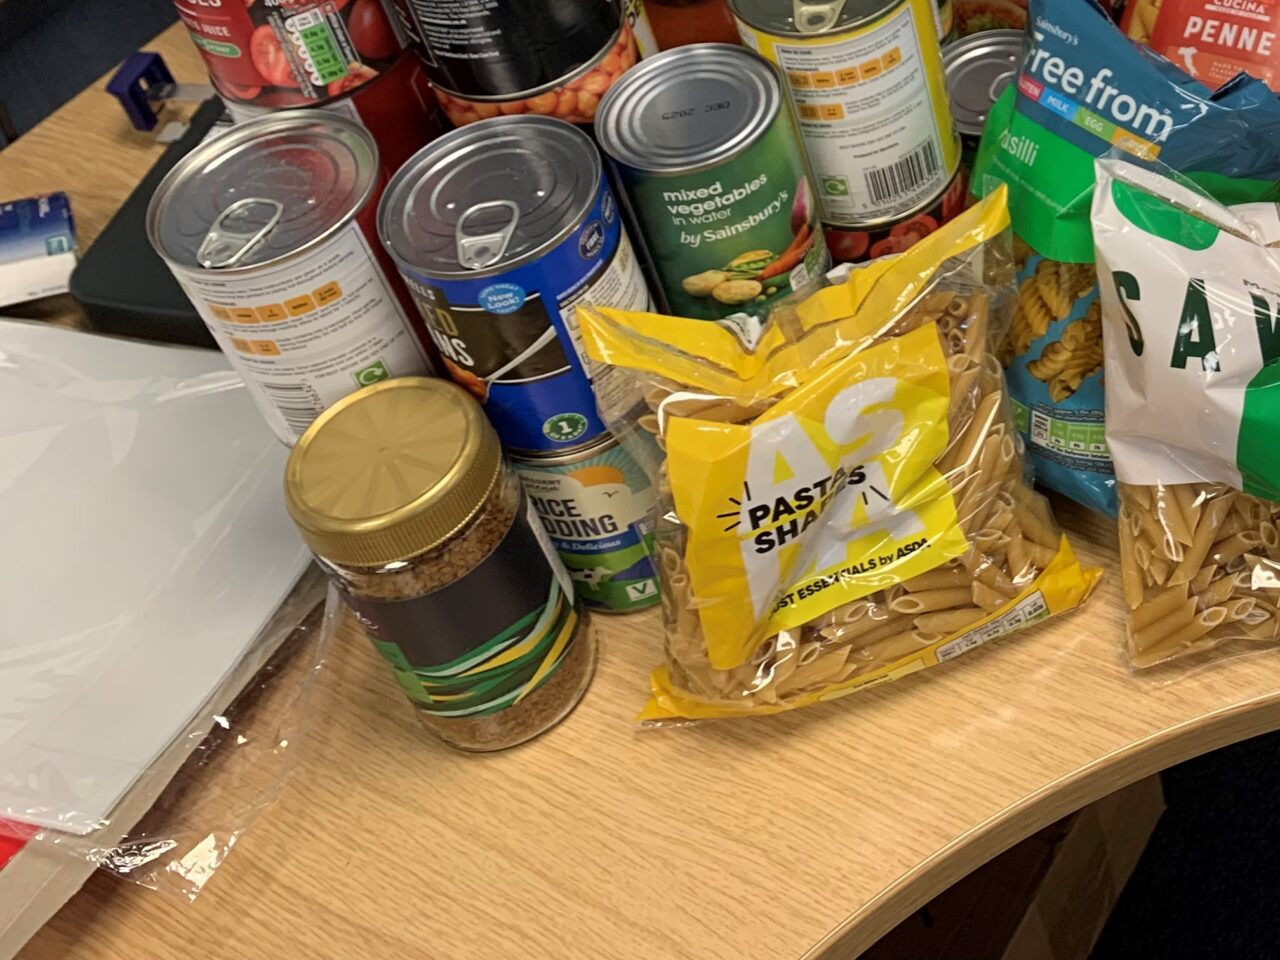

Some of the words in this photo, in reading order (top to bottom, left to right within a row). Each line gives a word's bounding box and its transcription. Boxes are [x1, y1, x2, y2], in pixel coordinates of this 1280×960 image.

[1036, 16, 1079, 46] Sainsbury's
[1183, 16, 1277, 56] PENNE
[1046, 95, 1070, 113] MILK
[1084, 68, 1174, 142] from
[1084, 116, 1103, 132] EGG
[663, 181, 723, 202] mixed
[666, 173, 768, 216] vegetables
[672, 215, 686, 226] in
[689, 208, 731, 225] water
[680, 232, 702, 248] by
[703, 190, 788, 242] Sainsbury's
[487, 292, 514, 303] New
[558, 421, 572, 434] 1
[541, 514, 618, 538] DDING
[572, 539, 622, 551] Delicious
[879, 553, 894, 568] by
[895, 538, 931, 560] ASDA
